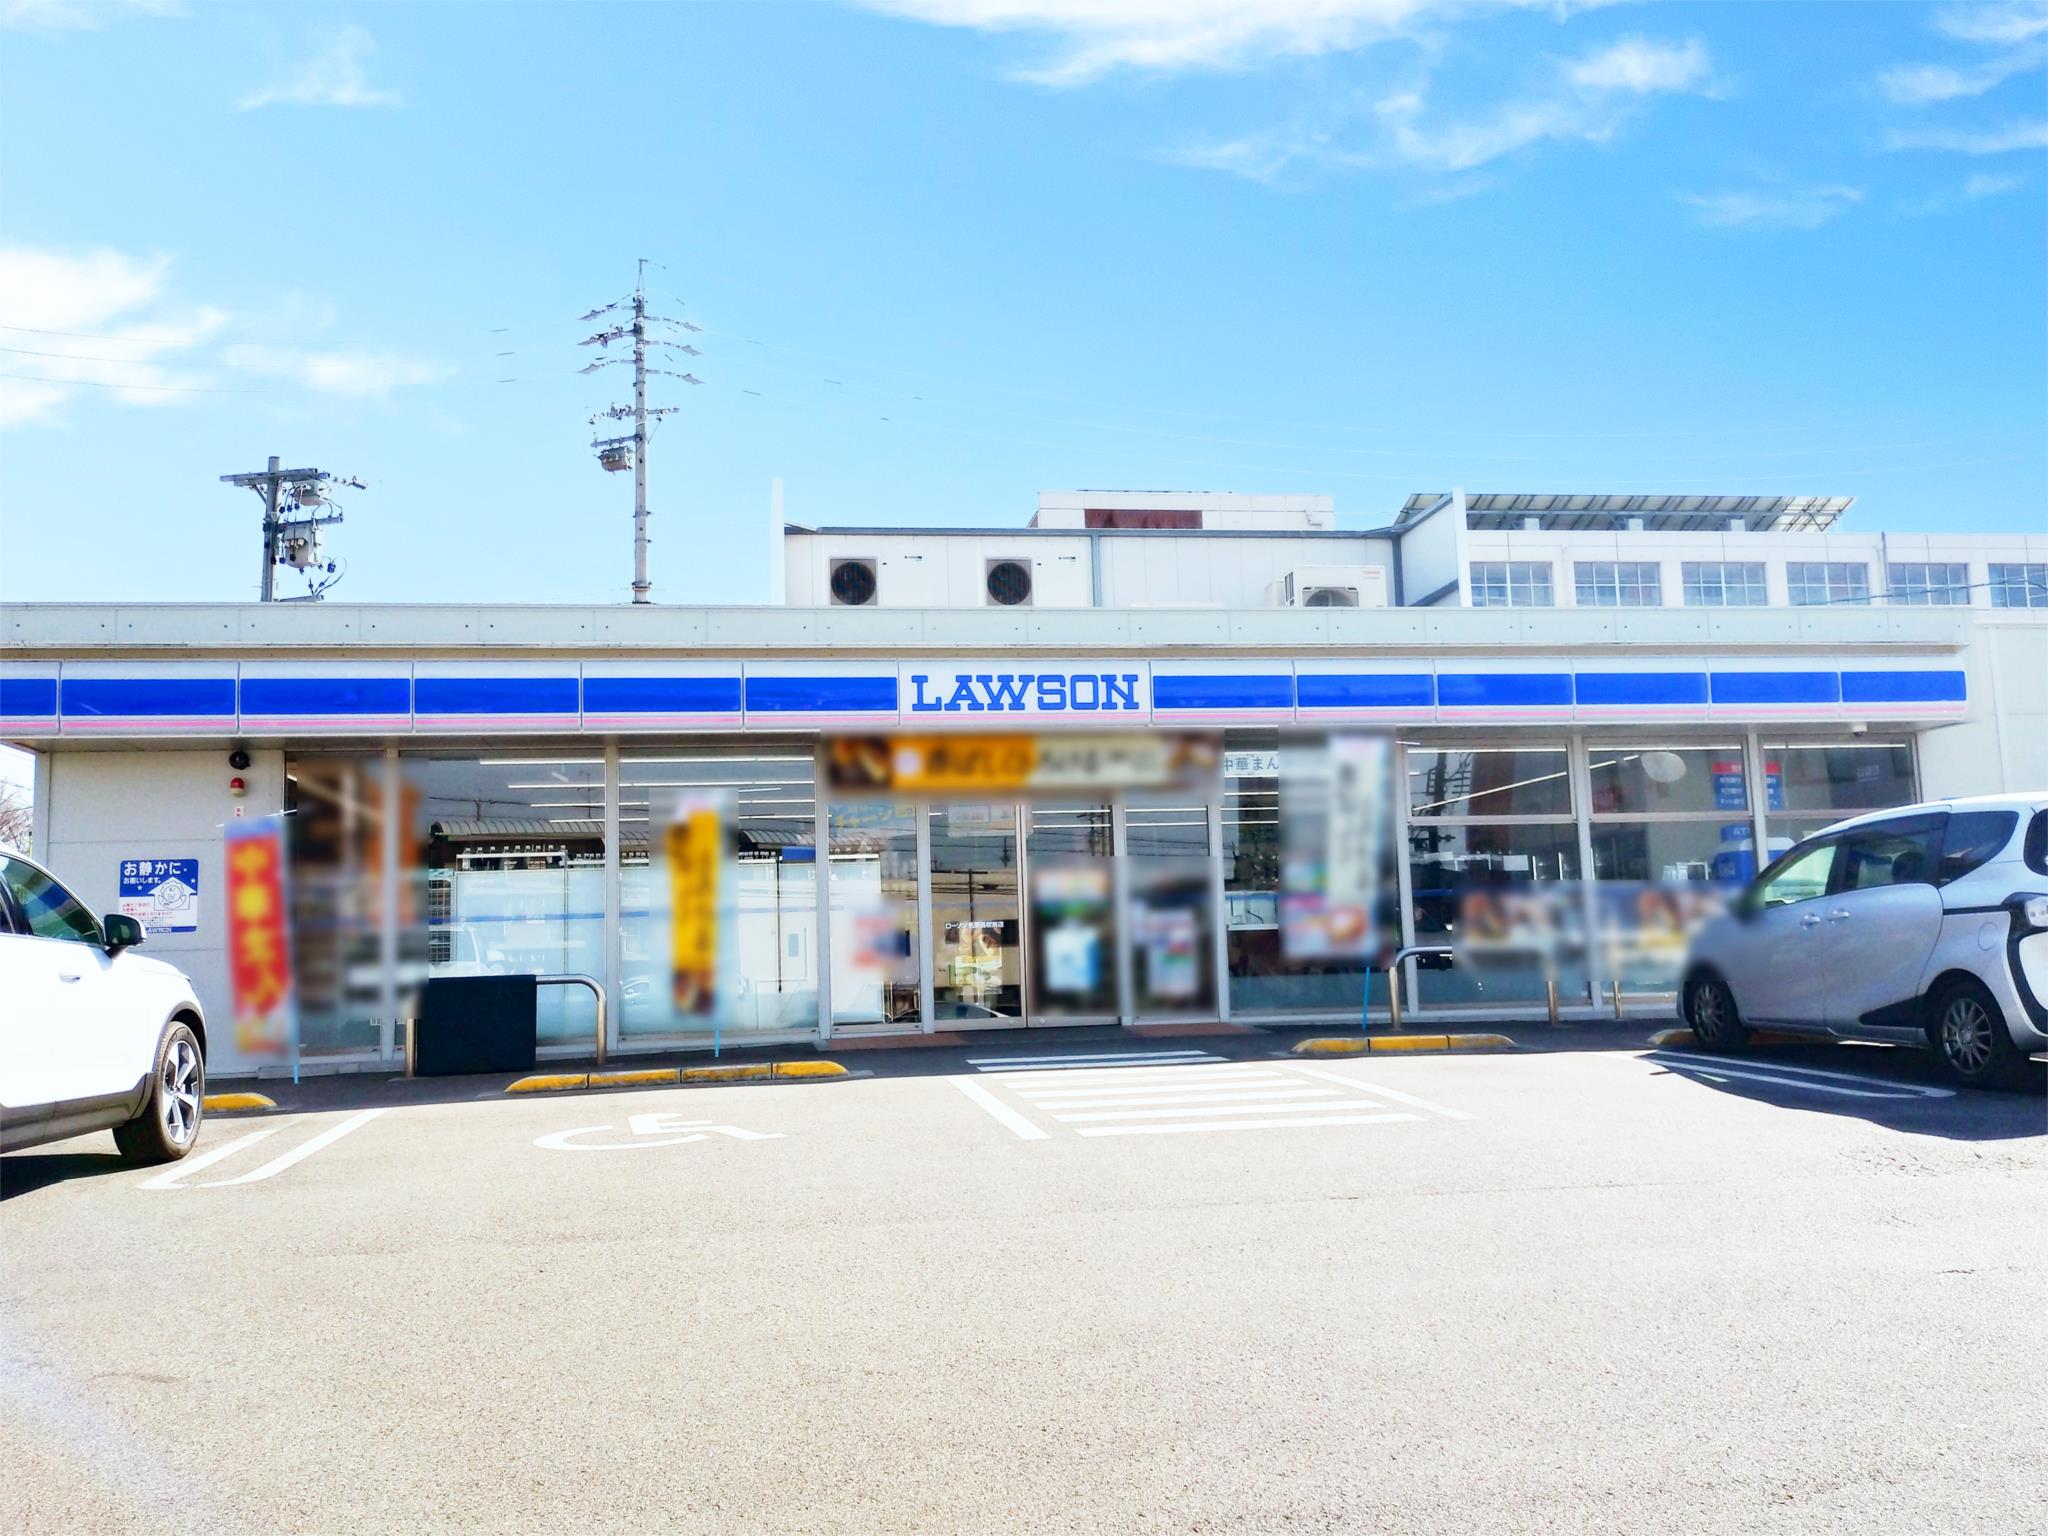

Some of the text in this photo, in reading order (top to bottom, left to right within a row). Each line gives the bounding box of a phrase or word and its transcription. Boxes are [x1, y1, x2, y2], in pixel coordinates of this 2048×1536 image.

[911, 674, 1140, 711] LAWSON
[123, 861, 181, 876] お静かに
